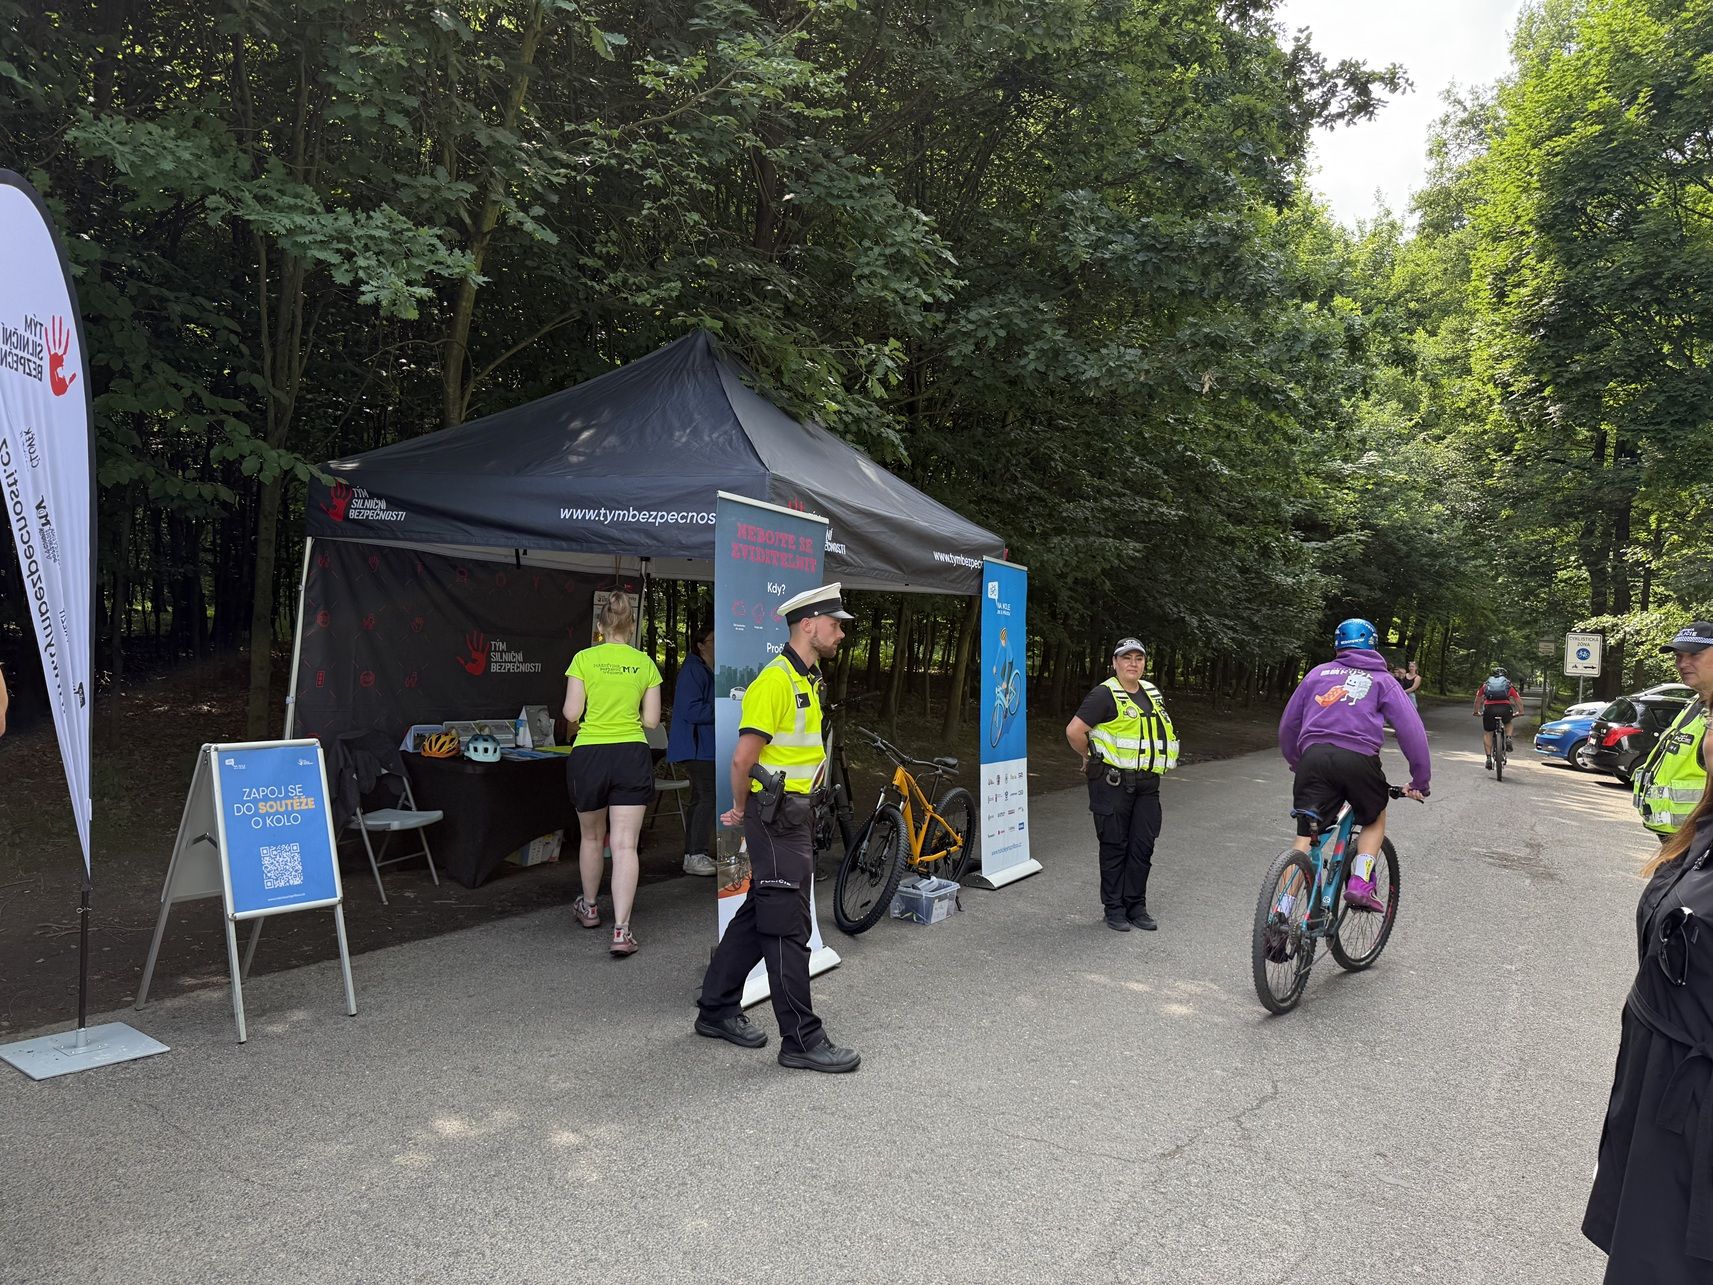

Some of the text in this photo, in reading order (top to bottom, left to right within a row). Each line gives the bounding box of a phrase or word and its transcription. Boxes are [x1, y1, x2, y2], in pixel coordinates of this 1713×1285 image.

[352, 485, 369, 498] TÝM
[351, 497, 387, 510] SILNIČNÍ
[349, 508, 406, 521] BEZPEČNOSTI
[560, 507, 717, 526] www.tymbezpecnos
[738, 523, 814, 554] NEBOJTE SE
[933, 551, 983, 570] www.tymbezpec
[767, 581, 786, 597] Kdy?
[490, 639, 507, 651] TÝM
[766, 642, 785, 654] Proč
[490, 650, 523, 662] SILNIČNÍ
[490, 660, 542, 673] BEZPEČNOSTI
[243, 784, 304, 800] ZAPOJ SE
[234, 796, 316, 816] DO SOUTĚŽE
[251, 813, 301, 829] O KOLO
